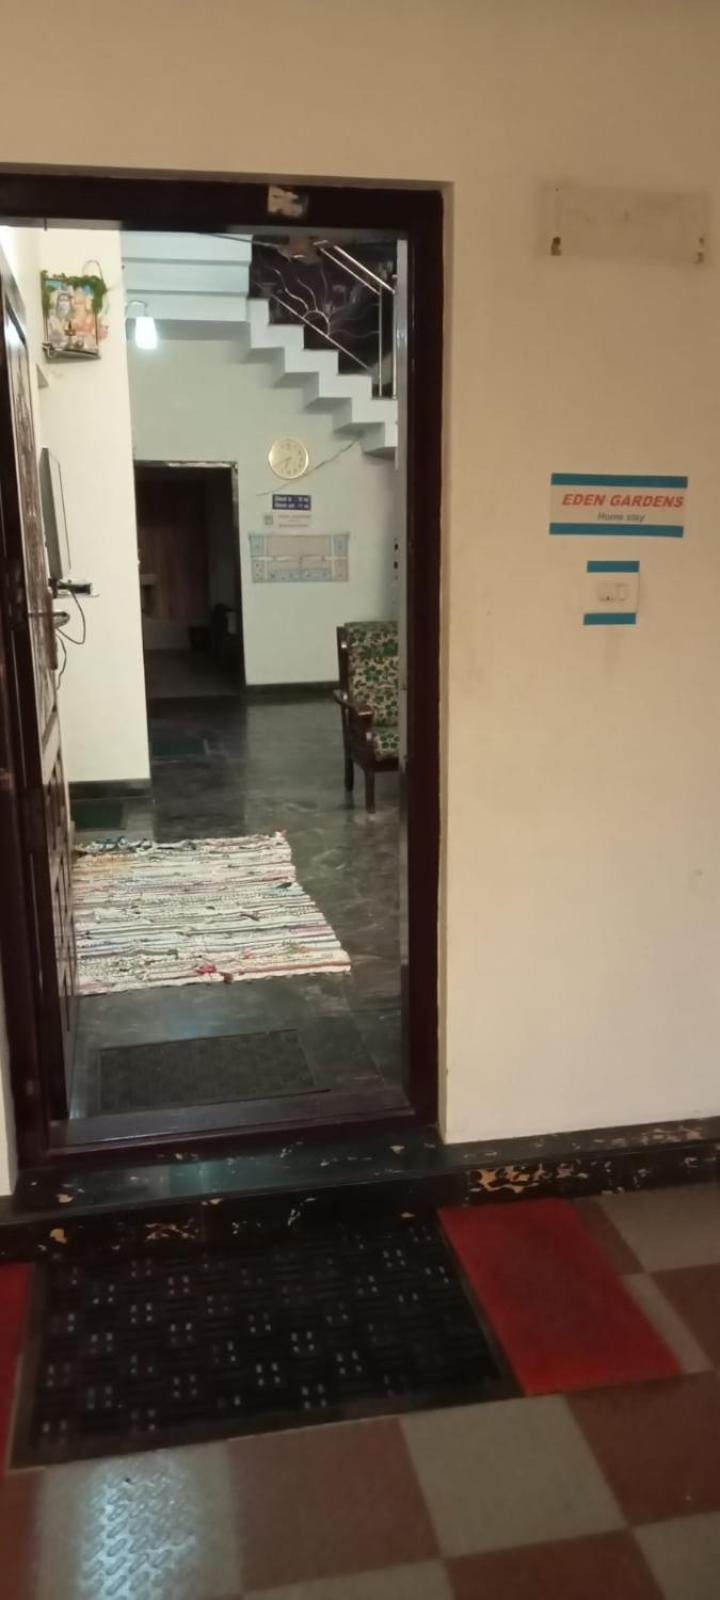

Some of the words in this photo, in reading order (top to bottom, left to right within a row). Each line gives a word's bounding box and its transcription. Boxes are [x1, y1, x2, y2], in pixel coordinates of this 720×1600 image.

[562, 493, 606, 507] EDEN
[609, 494, 685, 508] GARDENS
[597, 512, 624, 521] Home
[626, 513, 646, 523] stay
